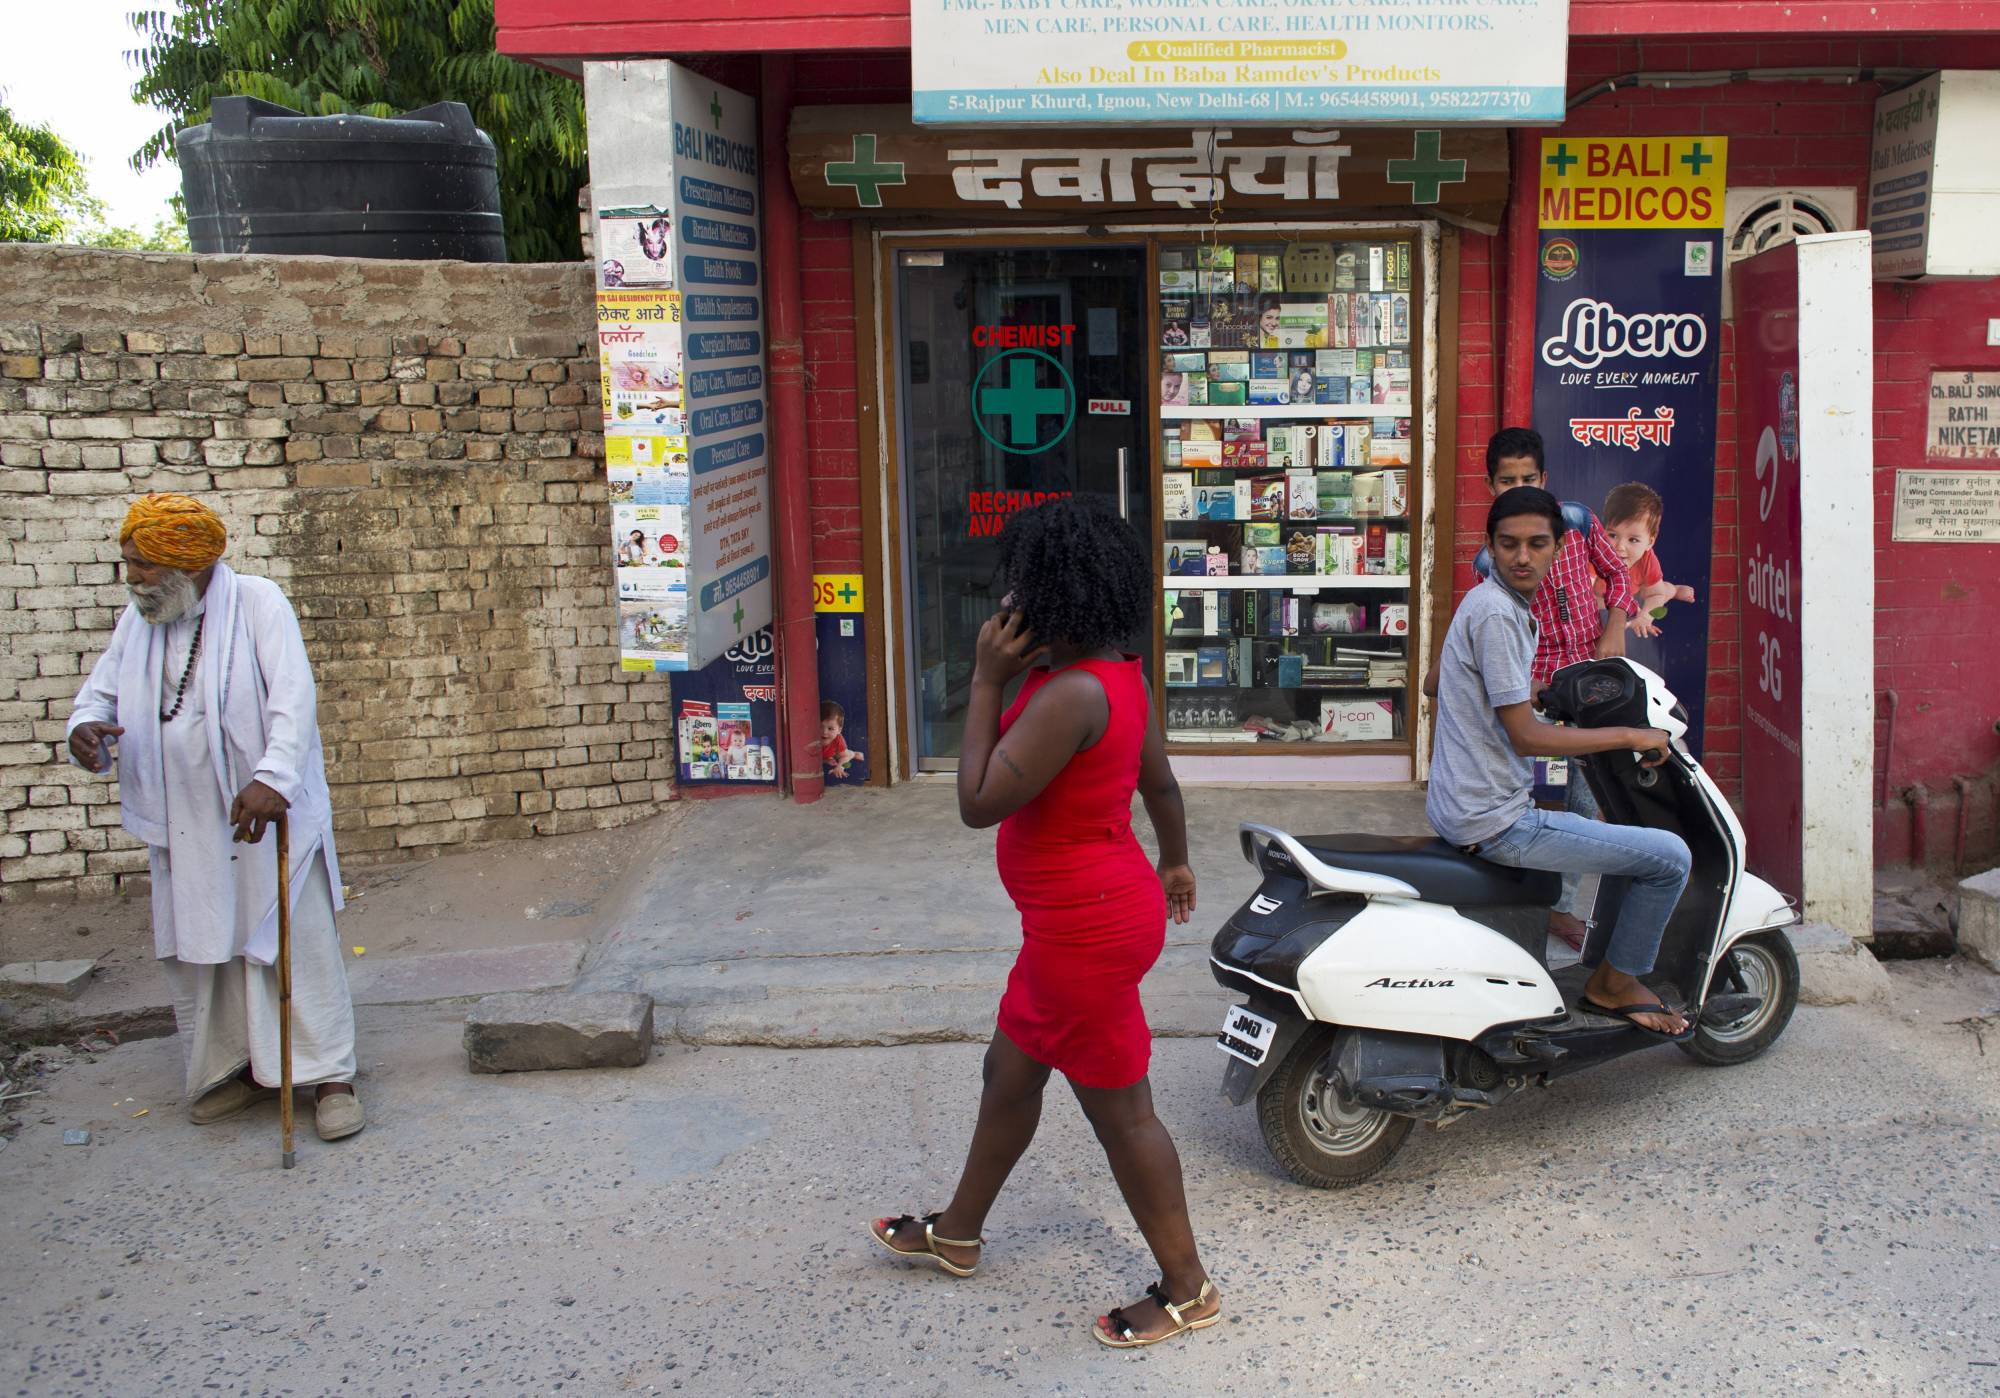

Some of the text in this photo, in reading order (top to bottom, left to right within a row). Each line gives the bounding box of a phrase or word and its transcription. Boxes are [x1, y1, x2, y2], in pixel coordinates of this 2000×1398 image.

[984, 18, 1029, 34] MEN
[1036, 17, 1097, 34] CARE,
[1103, 16, 1211, 33] PERSONAL
[1286, 15, 1369, 31] HEALTH
[1376, 14, 1494, 31] MONITORS.
[1138, 41, 1337, 58] A Qualified Pharmacist
[1036, 64, 1441, 83] Also Deal In Baba Ramdev's Products
[948, 96, 1025, 112] 5-Rajpur
[1031, 94, 1091, 110] Khurd,
[1098, 94, 1150, 111] Ignou,
[1156, 93, 1192, 108] New
[1199, 92, 1271, 108] Delhi-68
[1320, 91, 1424, 109] 9654458901,
[1431, 91, 1532, 107] 9582277370
[674, 122, 702, 161] BALI
[1587, 143, 1671, 178] BALI
[1543, 186, 1713, 222] MEDICOS
[704, 259, 742, 280] Health Foods
[694, 297, 753, 321] Health Supplements
[972, 324, 1076, 347] CHEMIST
[1541, 298, 1707, 370] Libero
[700, 336, 725, 357] Surgical
[692, 375, 708, 396] Baby
[725, 370, 747, 388] Women
[748, 368, 760, 384] Care
[1560, 372, 1700, 385] LOVE EVERY MOMENT
[1090, 402, 1127, 412] PULL
[1948, 406, 1988, 421] RATHI
[1569, 406, 1675, 451] दवाईयाँ
[712, 441, 751, 464] Personal Care
[1909, 489, 1928, 497] Wing
[1930, 488, 1972, 496] Commander
[1933, 529, 1946, 537] Air
[1948, 529, 1962, 537] HQ
[1748, 543, 1792, 623] airtel
[756, 664, 776, 673] EVER
[1759, 631, 1782, 702] 3G
[1339, 710, 1375, 722] i-can
[1364, 977, 1455, 988] Activa
